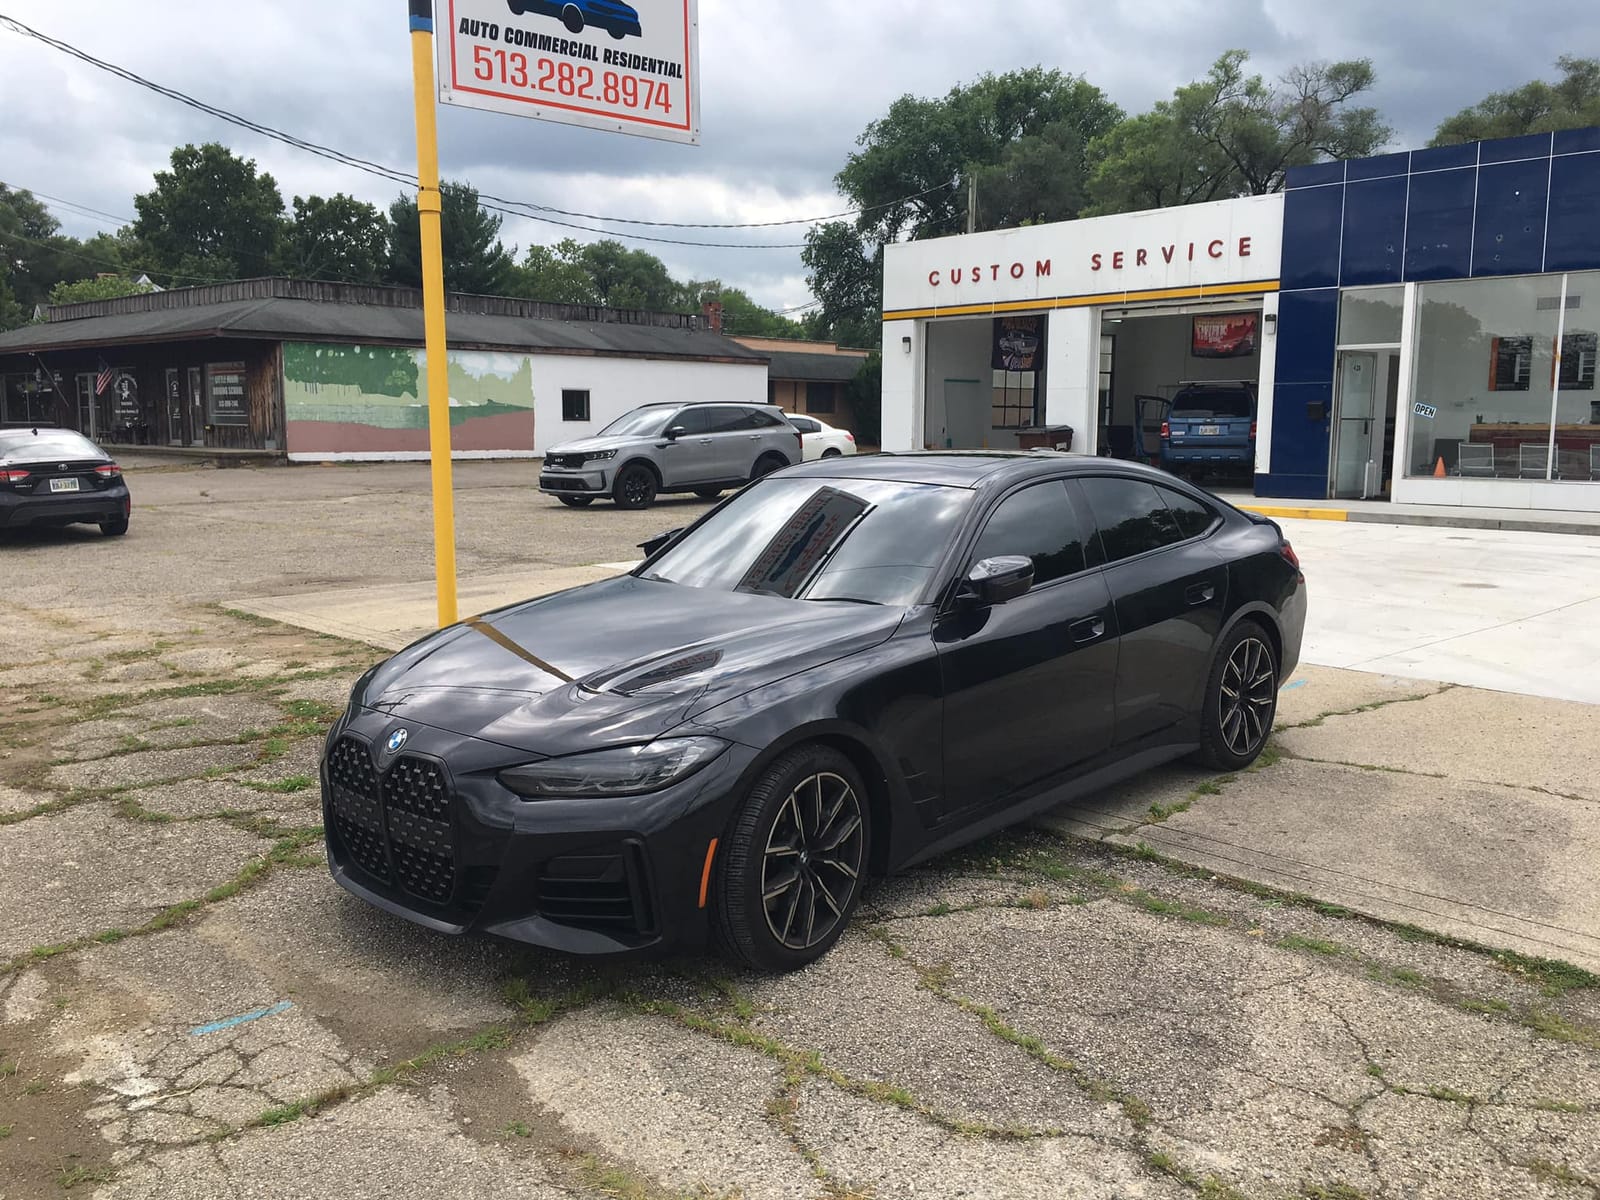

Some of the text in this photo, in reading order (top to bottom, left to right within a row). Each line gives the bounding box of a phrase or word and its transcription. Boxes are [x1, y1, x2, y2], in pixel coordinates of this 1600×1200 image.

[459, 17, 683, 79] AUTO COMMERCIAL RESIDENTIAL
[474, 45, 672, 113] 513.282.8974
[928, 236, 1252, 287] CUSTOM SERVICE
[1414, 403, 1435, 417] OPEN
